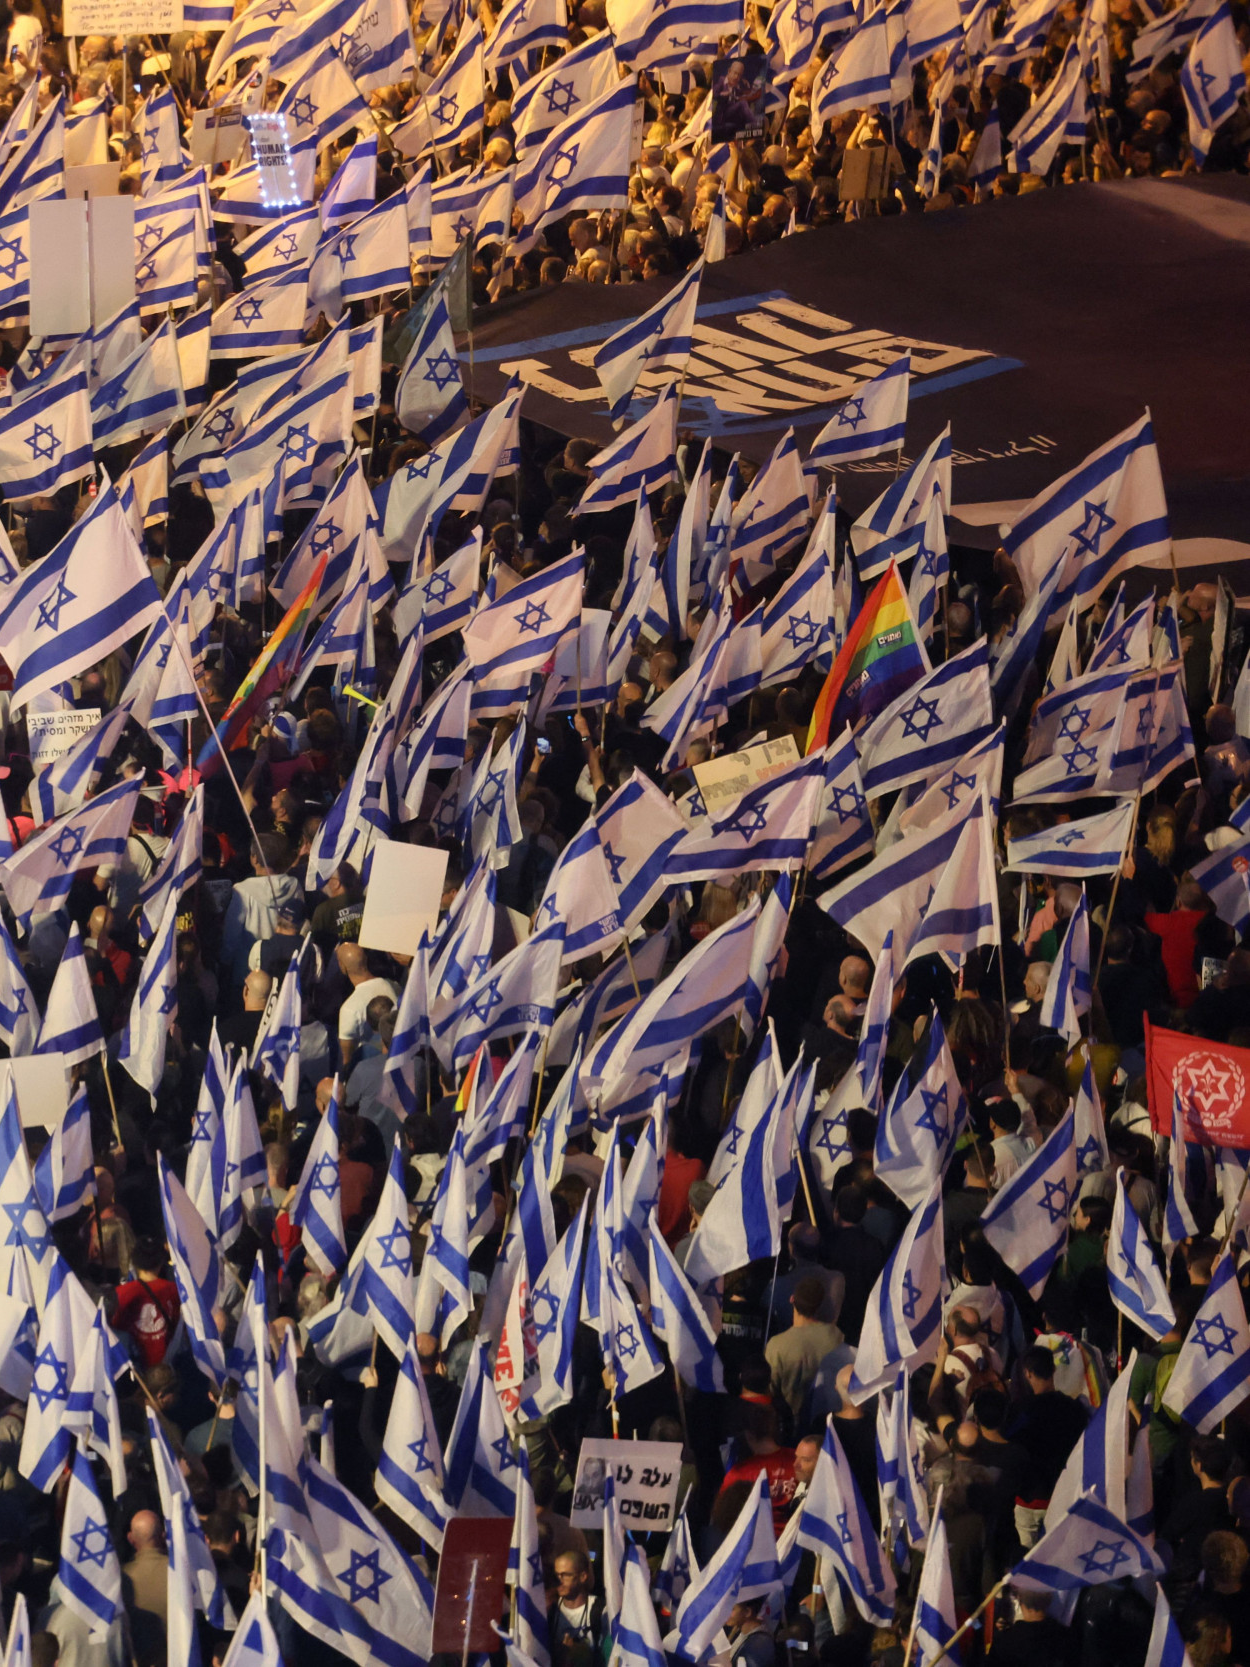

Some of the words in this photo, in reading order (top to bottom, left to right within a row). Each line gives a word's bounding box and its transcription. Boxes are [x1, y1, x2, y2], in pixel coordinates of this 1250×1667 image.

[256, 143, 286, 154] HUMAN
[259, 155, 288, 166] RIGHTS!
[28, 716, 55, 726] שביבי
[58, 714, 84, 724] מזהים
[86, 713, 101, 724] איך
[31, 727, 66, 737] ומסית?
[616, 1464, 633, 1484] לו
[639, 1466, 673, 1488] עלה
[619, 1499, 671, 1520] השפם
